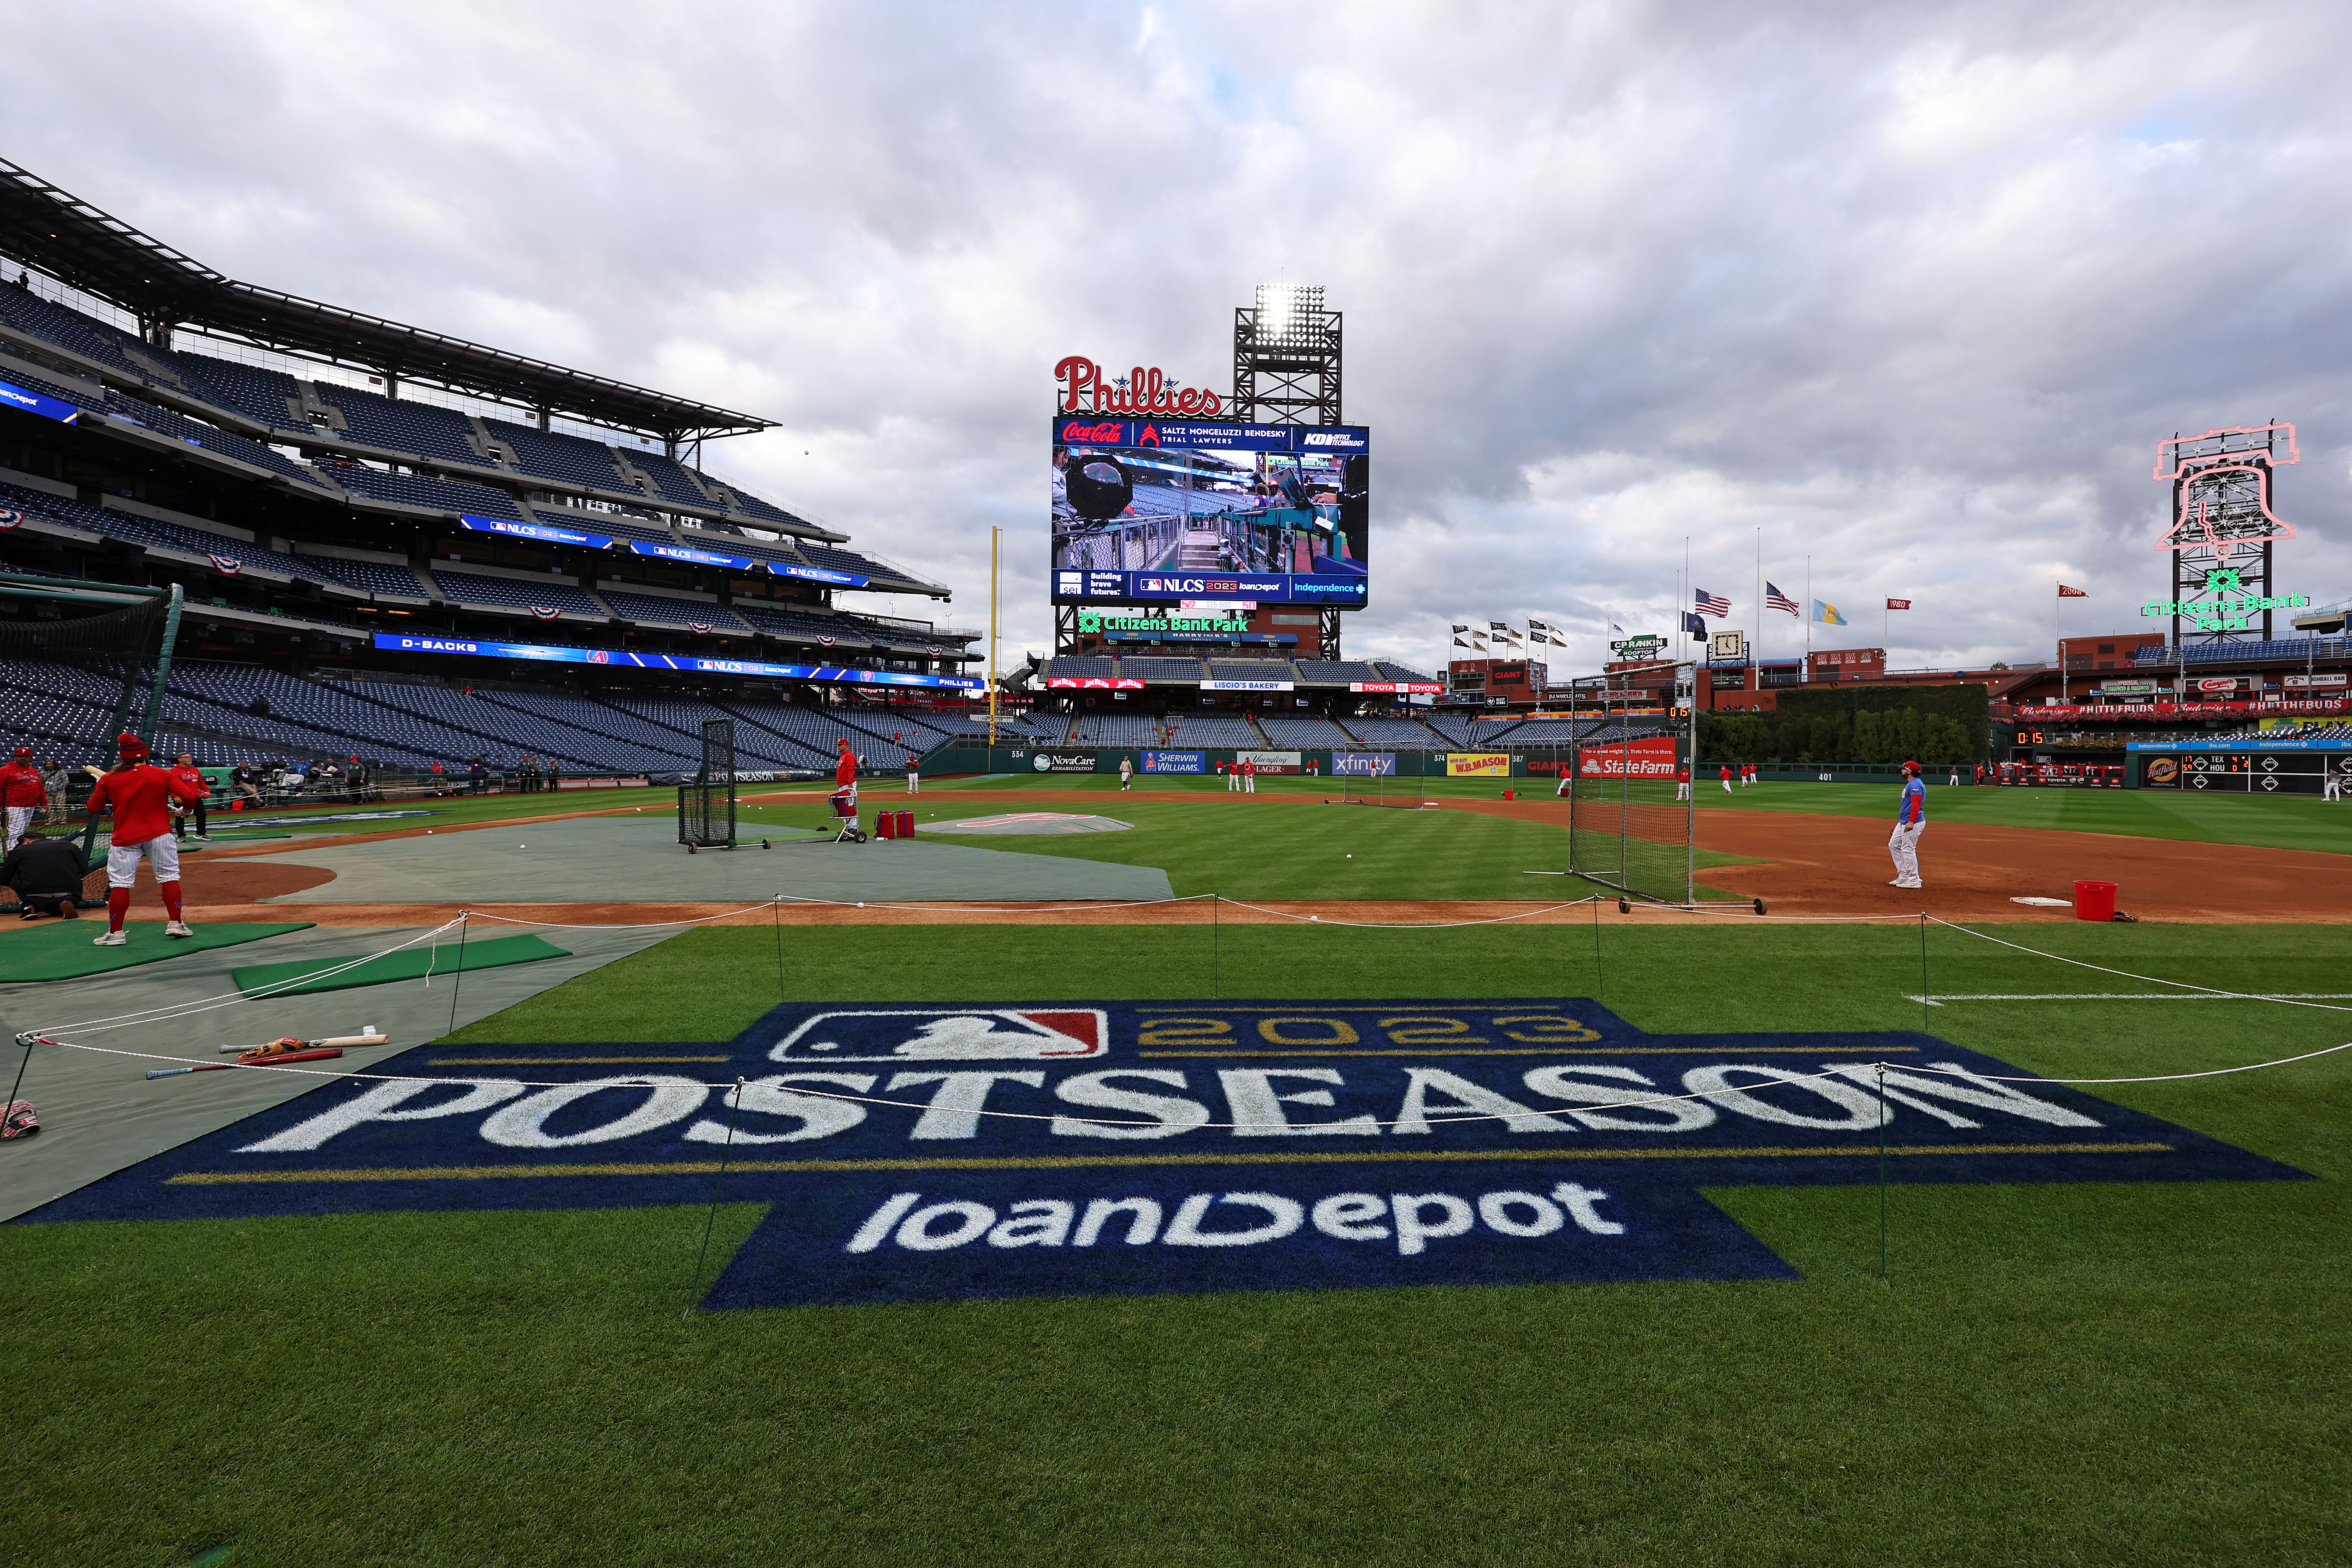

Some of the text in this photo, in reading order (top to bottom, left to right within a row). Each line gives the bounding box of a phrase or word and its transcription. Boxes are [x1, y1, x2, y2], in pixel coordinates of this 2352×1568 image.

[1054, 355, 1222, 416] Phillies
[0, 388, 37, 406] anDepot
[1062, 422, 1124, 442] Coca-Cola
[508, 524, 536, 535] NLCS
[667, 548, 691, 558] NLCS
[798, 569, 817, 577] NLCS
[1091, 573, 1121, 581] Building
[1164, 579, 1204, 592] NLCS
[1239, 583, 1279, 592] loanDepot
[1295, 583, 1354, 593] Independence
[2145, 592, 2306, 616] Citizens Bank
[1104, 616, 1248, 632] Citizens Bank Park
[2197, 614, 2247, 631] Park
[402, 639, 477, 652] D-BACKS
[1629, 639, 1663, 648] RANKIN
[714, 661, 742, 672] NLCS
[1062, 678, 1076, 688] BEAM
[1094, 679, 1109, 688] BEAM
[1127, 679, 1142, 689] BEAM
[2018, 732, 2043, 744] 0:15
[1051, 756, 1095, 765] NovaCare
[1158, 753, 1197, 762] SHERWIN
[1249, 753, 1289, 764] Yuengling
[1527, 761, 1568, 770] GIANT
[2147, 761, 2178, 778] Hatfield
[715, 771, 774, 782] POTSEASON
[1138, 1016, 1603, 1046] 2023
[231, 1062, 2106, 1153] POSTSEASON
[845, 1182, 1626, 1256] loanDepot
